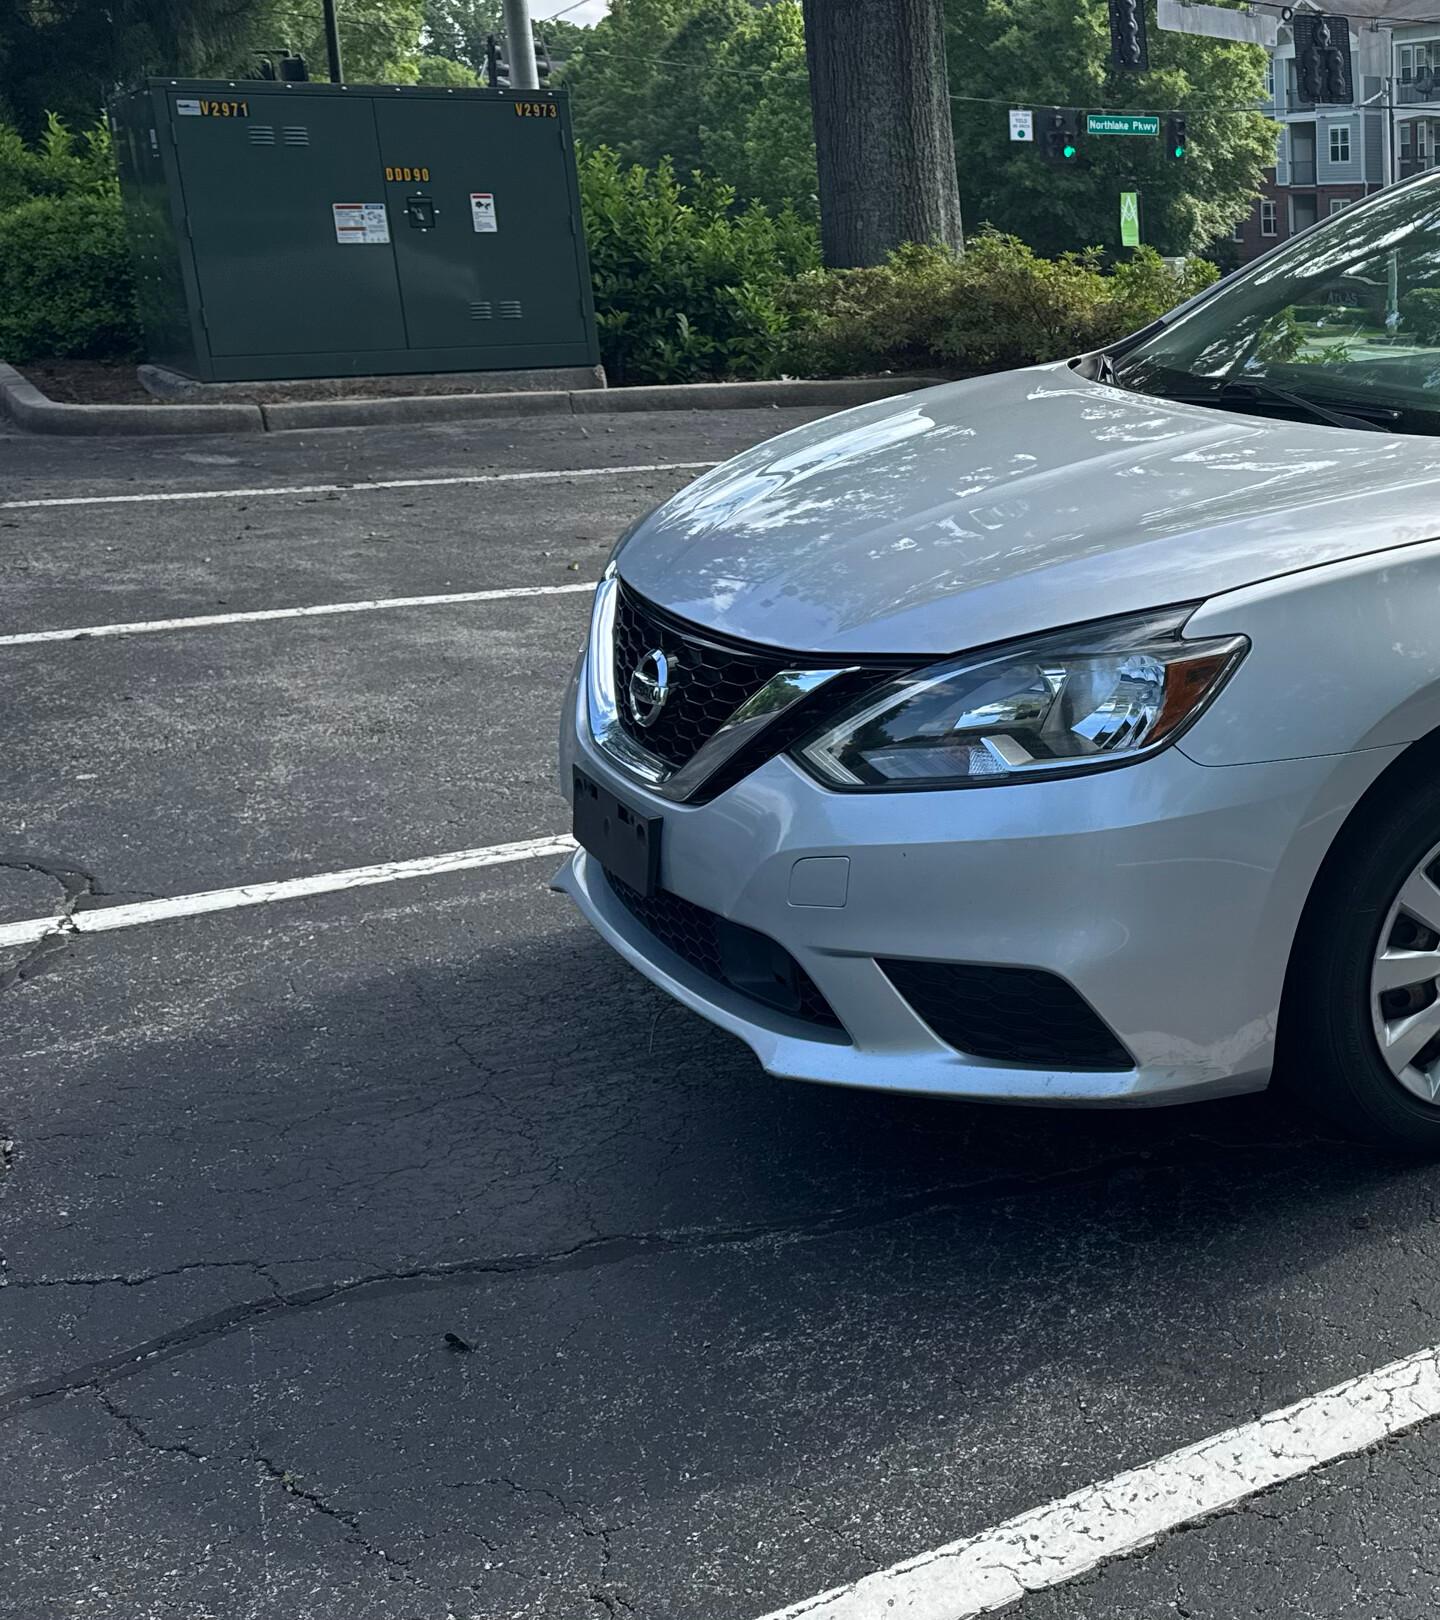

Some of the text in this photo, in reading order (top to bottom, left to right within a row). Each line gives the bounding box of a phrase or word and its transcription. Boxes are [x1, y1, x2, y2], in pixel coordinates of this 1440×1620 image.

[200, 101, 248, 117] V2971
[515, 103, 557, 118] V2973
[1089, 119, 1157, 134] Northlake Pkwy
